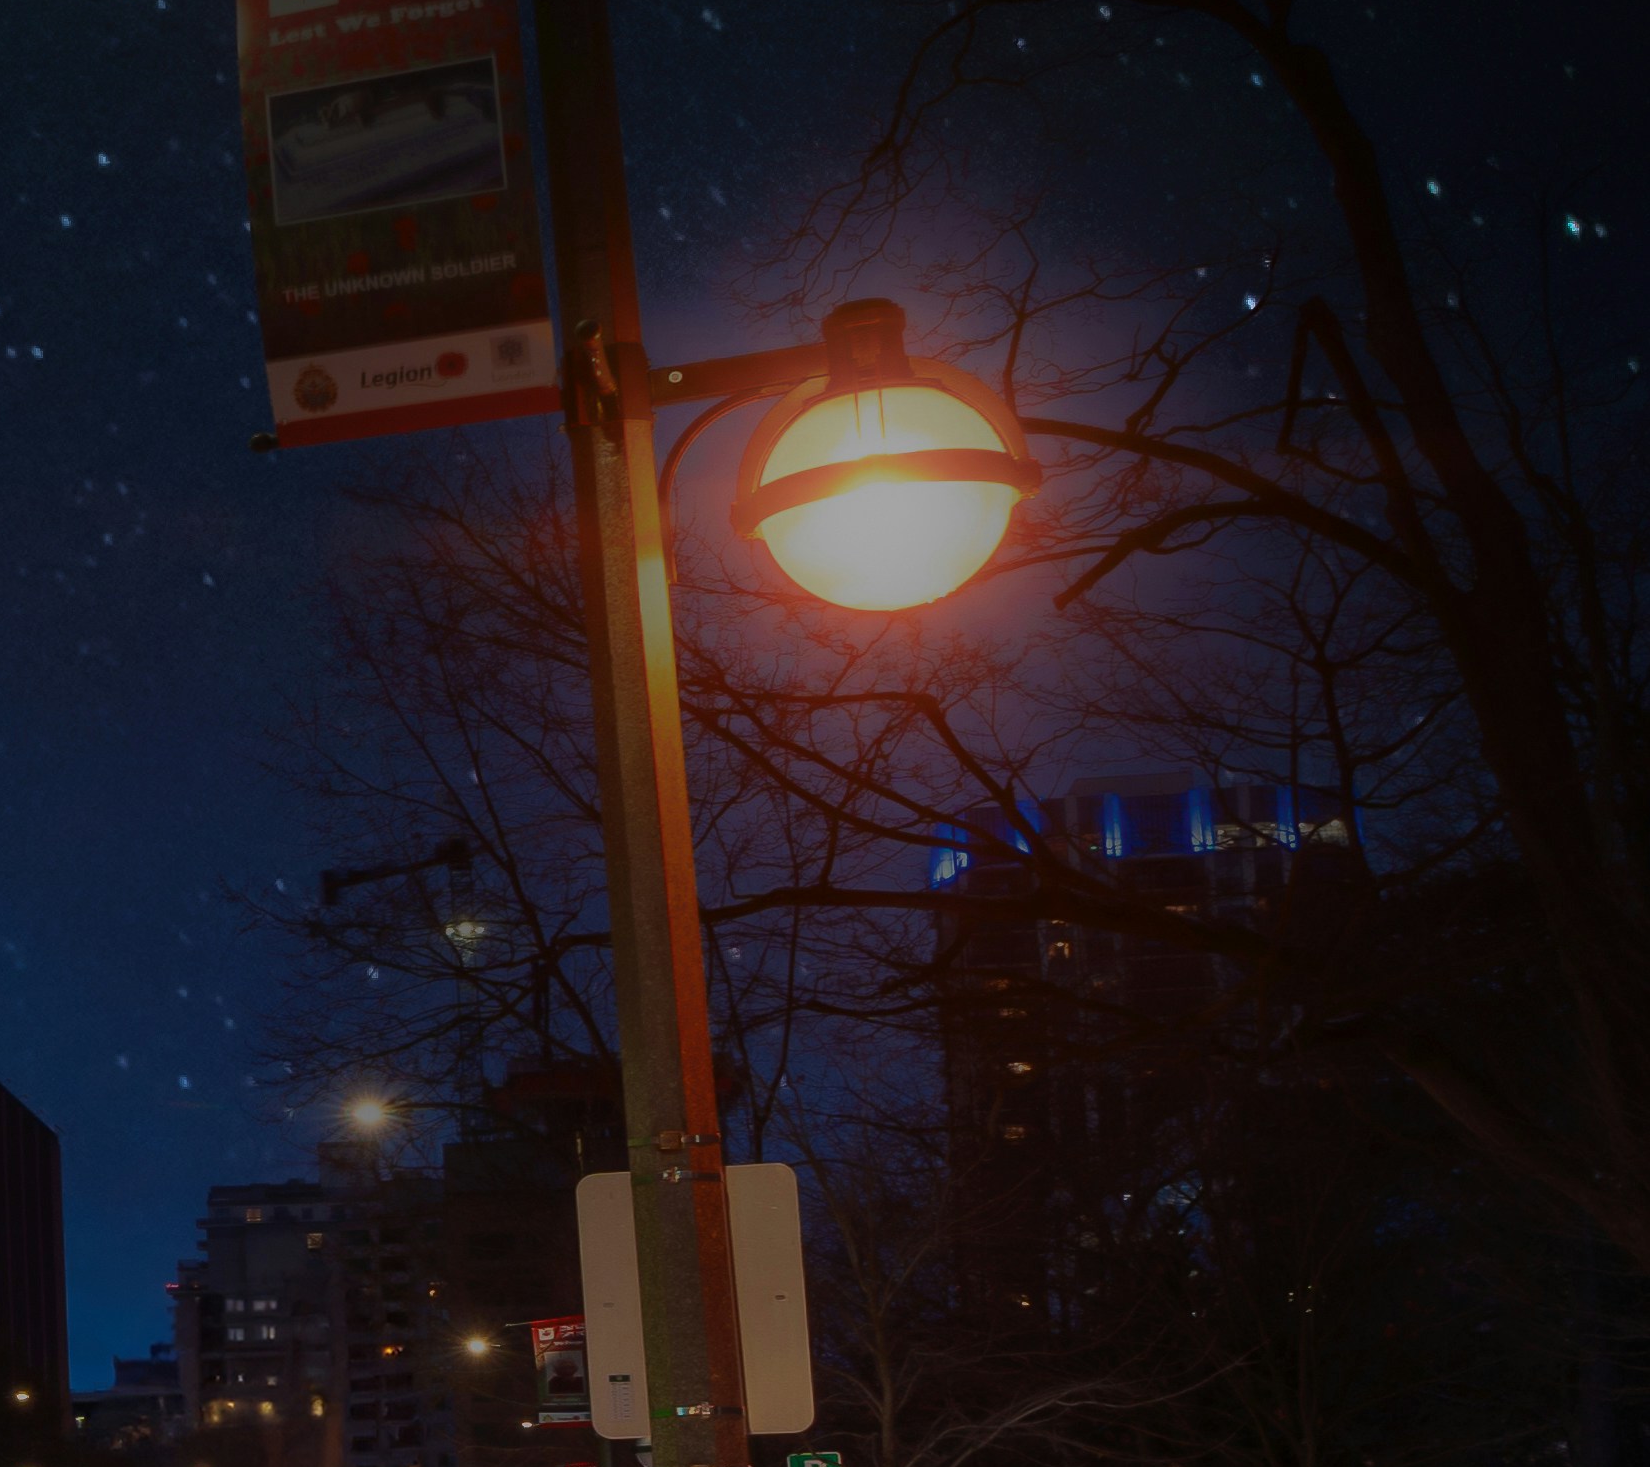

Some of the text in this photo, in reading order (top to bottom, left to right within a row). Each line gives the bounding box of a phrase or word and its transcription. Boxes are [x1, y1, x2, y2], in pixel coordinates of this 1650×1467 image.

[268, 17, 326, 48] Lest
[336, 9, 382, 34] We
[282, 252, 517, 304] THE UNKNOWN SOLDIER
[360, 364, 432, 390] Legion
